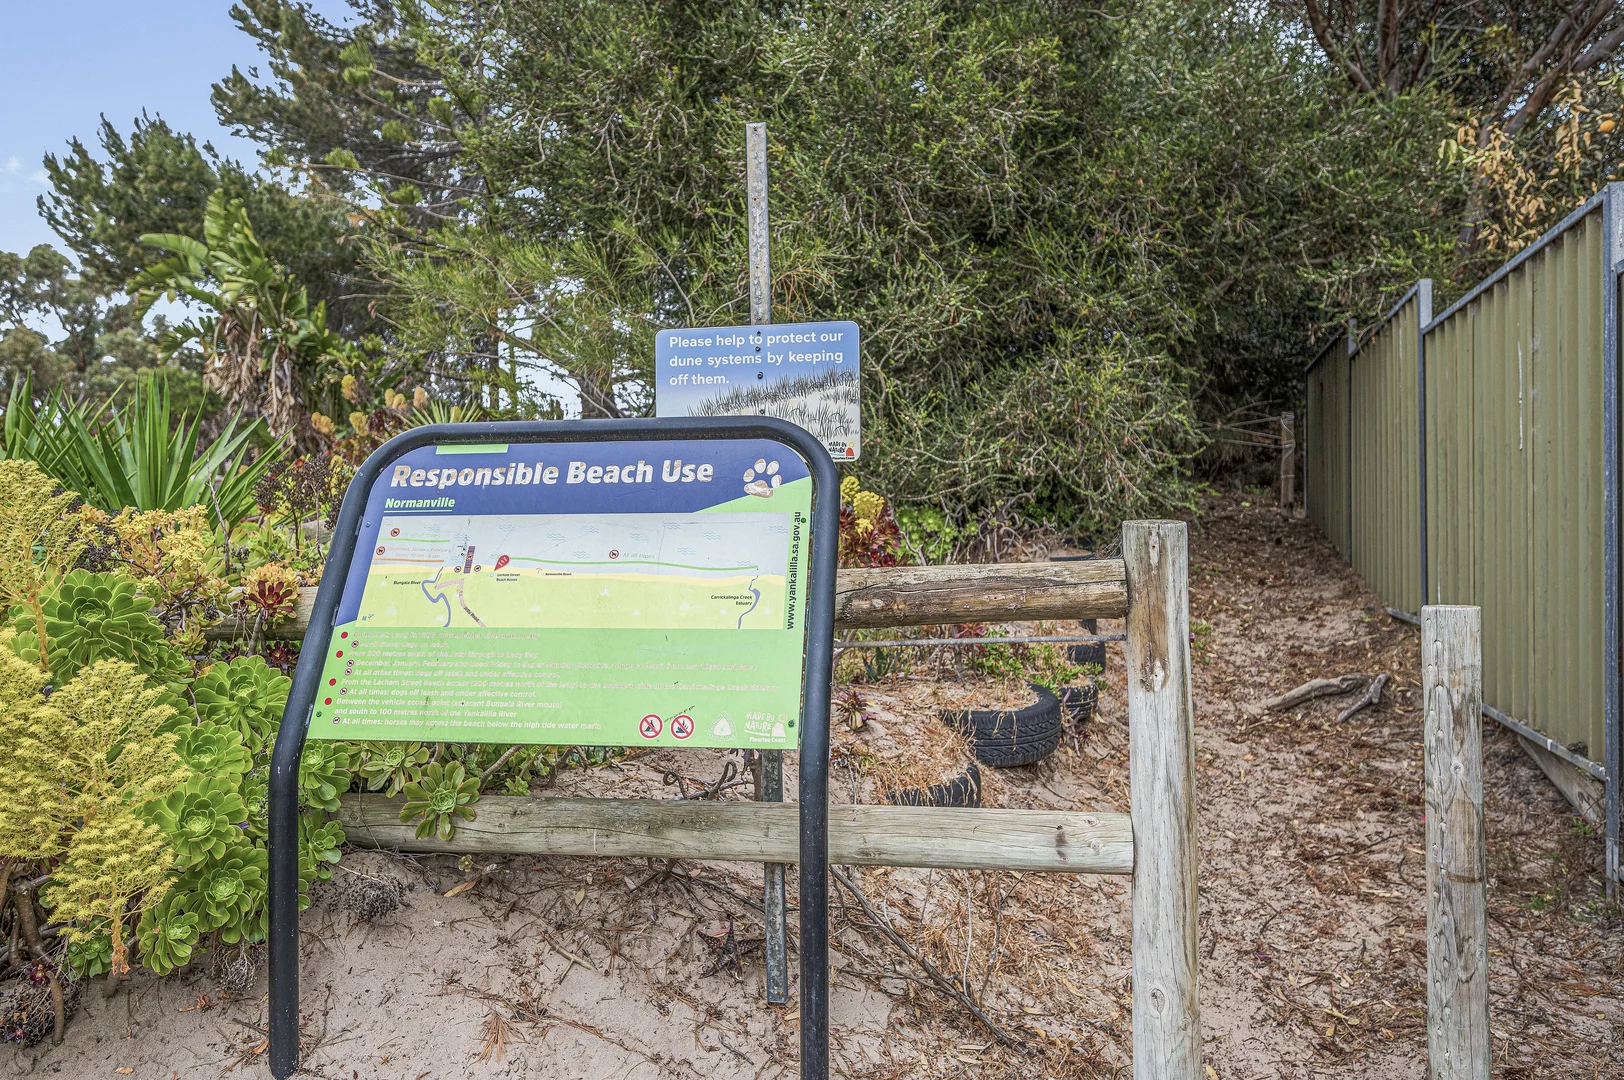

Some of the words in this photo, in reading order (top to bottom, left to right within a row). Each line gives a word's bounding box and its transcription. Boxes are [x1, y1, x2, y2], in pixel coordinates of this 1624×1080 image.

[670, 336, 712, 347] Please
[716, 334, 744, 347] help
[749, 334, 762, 345] to
[767, 332, 816, 346] protect
[821, 332, 843, 341] our
[670, 356, 702, 367] dune
[708, 354, 762, 368] systems
[768, 352, 783, 365] by
[789, 350, 842, 364] keeping
[670, 374, 688, 386] off
[692, 374, 729, 385] them.
[391, 462, 559, 489] Responsible
[566, 460, 653, 484] Beach
[662, 460, 714, 482] Use
[385, 496, 455, 508] Normanville
[787, 512, 801, 630] www.yankalilla.sa.gov.au
[391, 689, 408, 697] dogs
[745, 711, 765, 720] MADE
[766, 713, 774, 722] BY
[744, 721, 772, 731] NATURE
